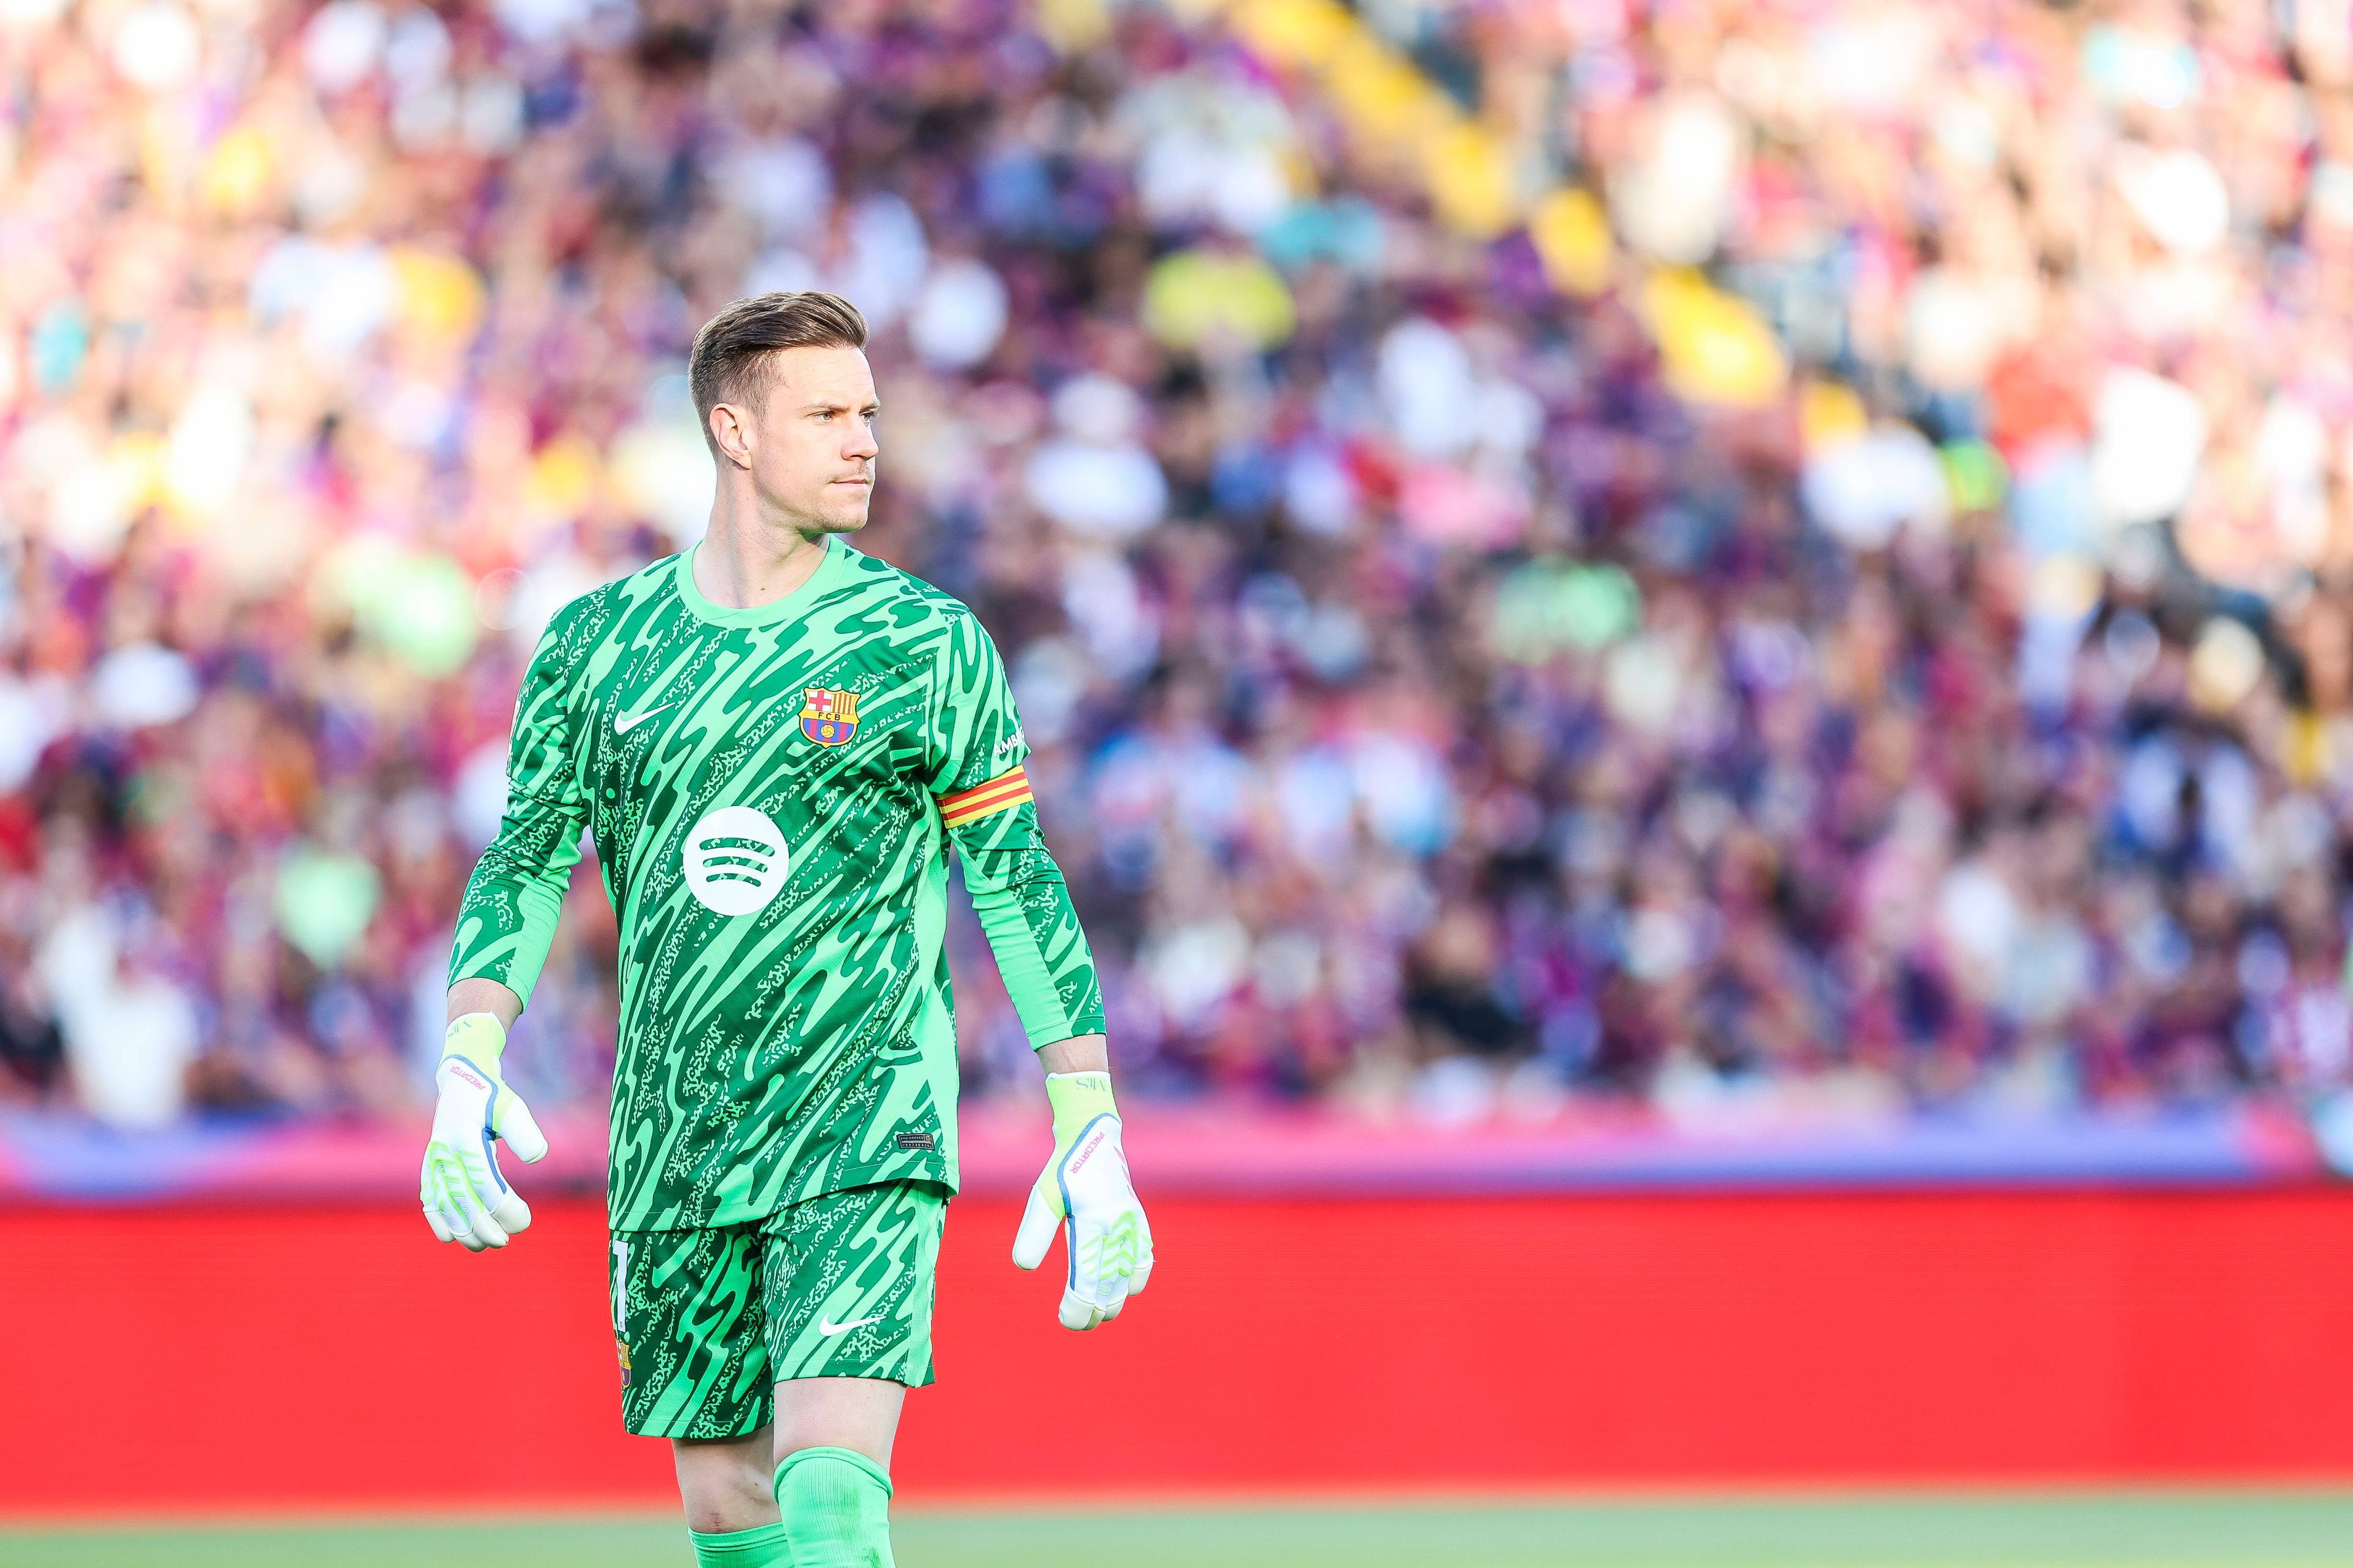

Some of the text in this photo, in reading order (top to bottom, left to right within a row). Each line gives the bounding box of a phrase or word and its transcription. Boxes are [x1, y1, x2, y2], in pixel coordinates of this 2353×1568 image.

[818, 712, 841, 720] FCB
[449, 1065, 486, 1090] PREDATOR
[1069, 1131, 1105, 1174] PREDATOR
